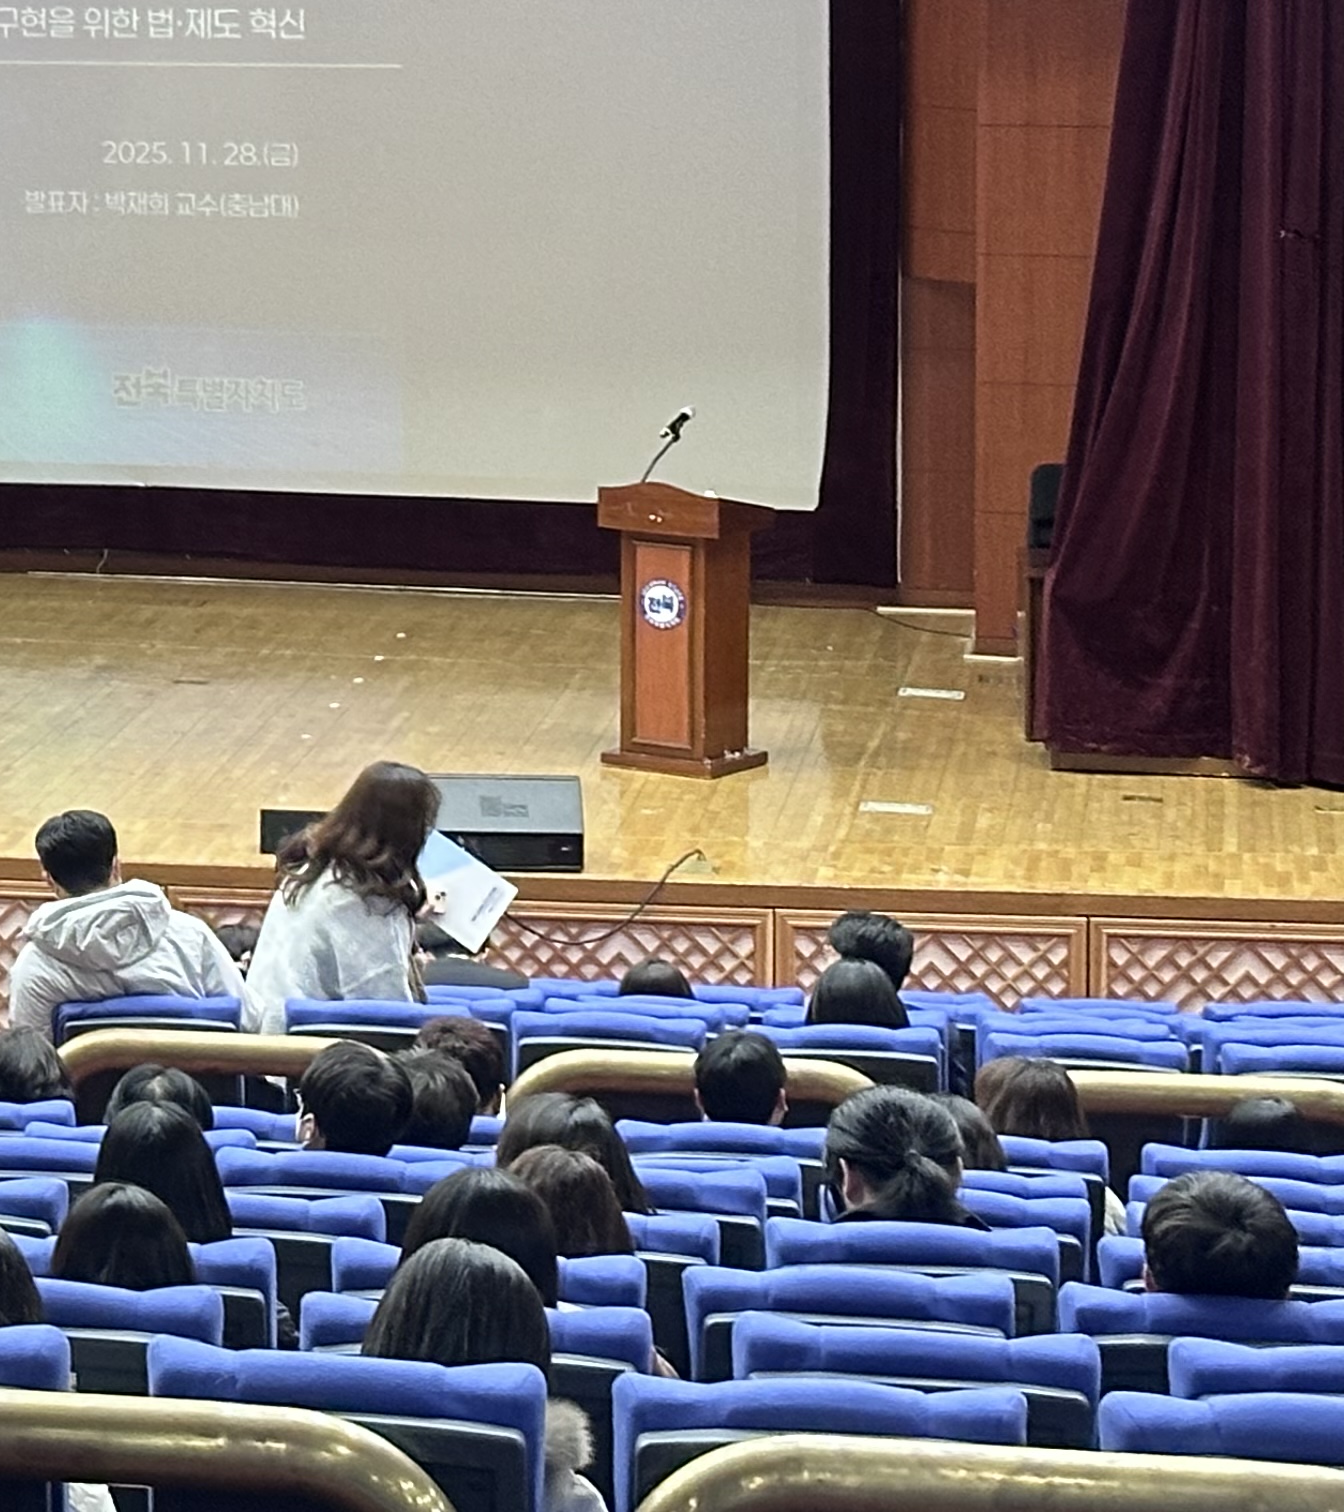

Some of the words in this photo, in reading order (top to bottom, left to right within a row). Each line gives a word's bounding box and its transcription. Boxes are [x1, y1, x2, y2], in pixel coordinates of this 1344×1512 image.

[83, 7, 140, 38] 위한
[249, 8, 305, 39] 혁신
[103, 140, 172, 164] 2025.
[181, 141, 216, 164] 11.
[25, 190, 88, 214] 발표자
